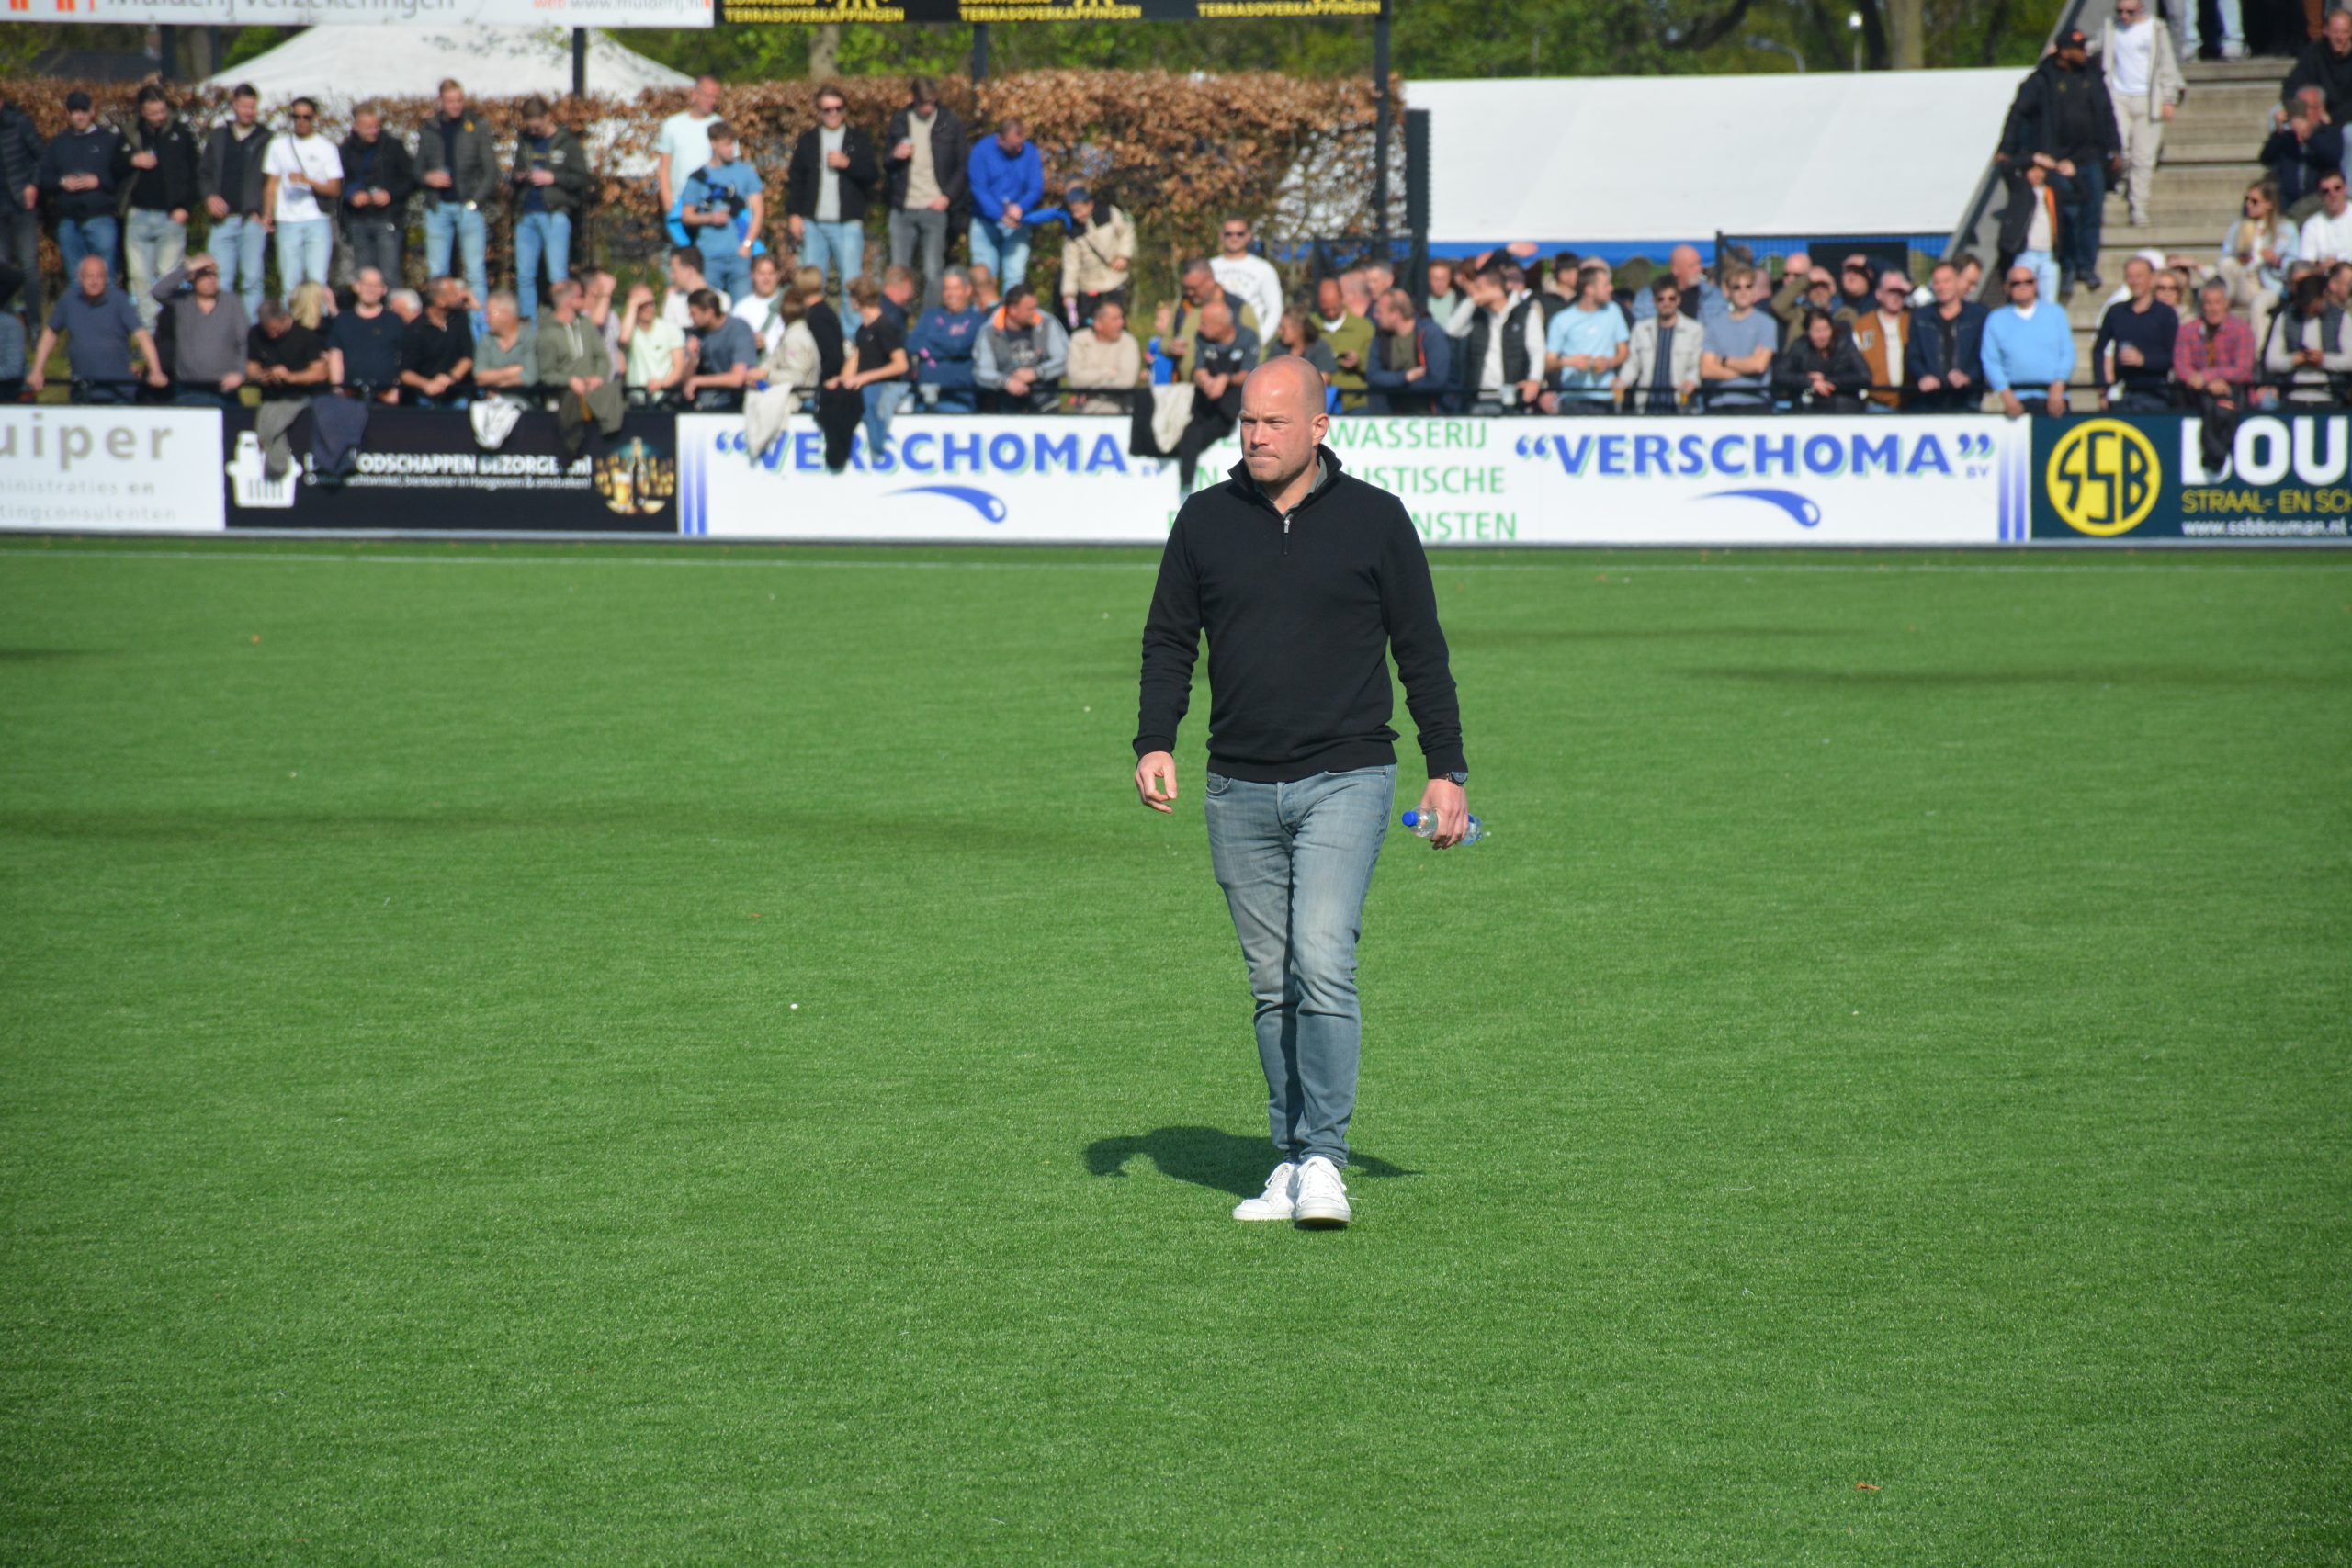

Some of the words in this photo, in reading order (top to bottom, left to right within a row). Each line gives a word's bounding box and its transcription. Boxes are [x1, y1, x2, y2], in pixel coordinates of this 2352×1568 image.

[724, 7, 905, 22] TERRASOVERKAPPINGEN
[958, 5, 1142, 21] TERRASOVERKAPPINGEN
[1329, 420, 1487, 449] WASSERIJ
[127, 480, 155, 495] en
[1348, 467, 1506, 494] ISTISCHE
[2278, 489, 2312, 514] EN
